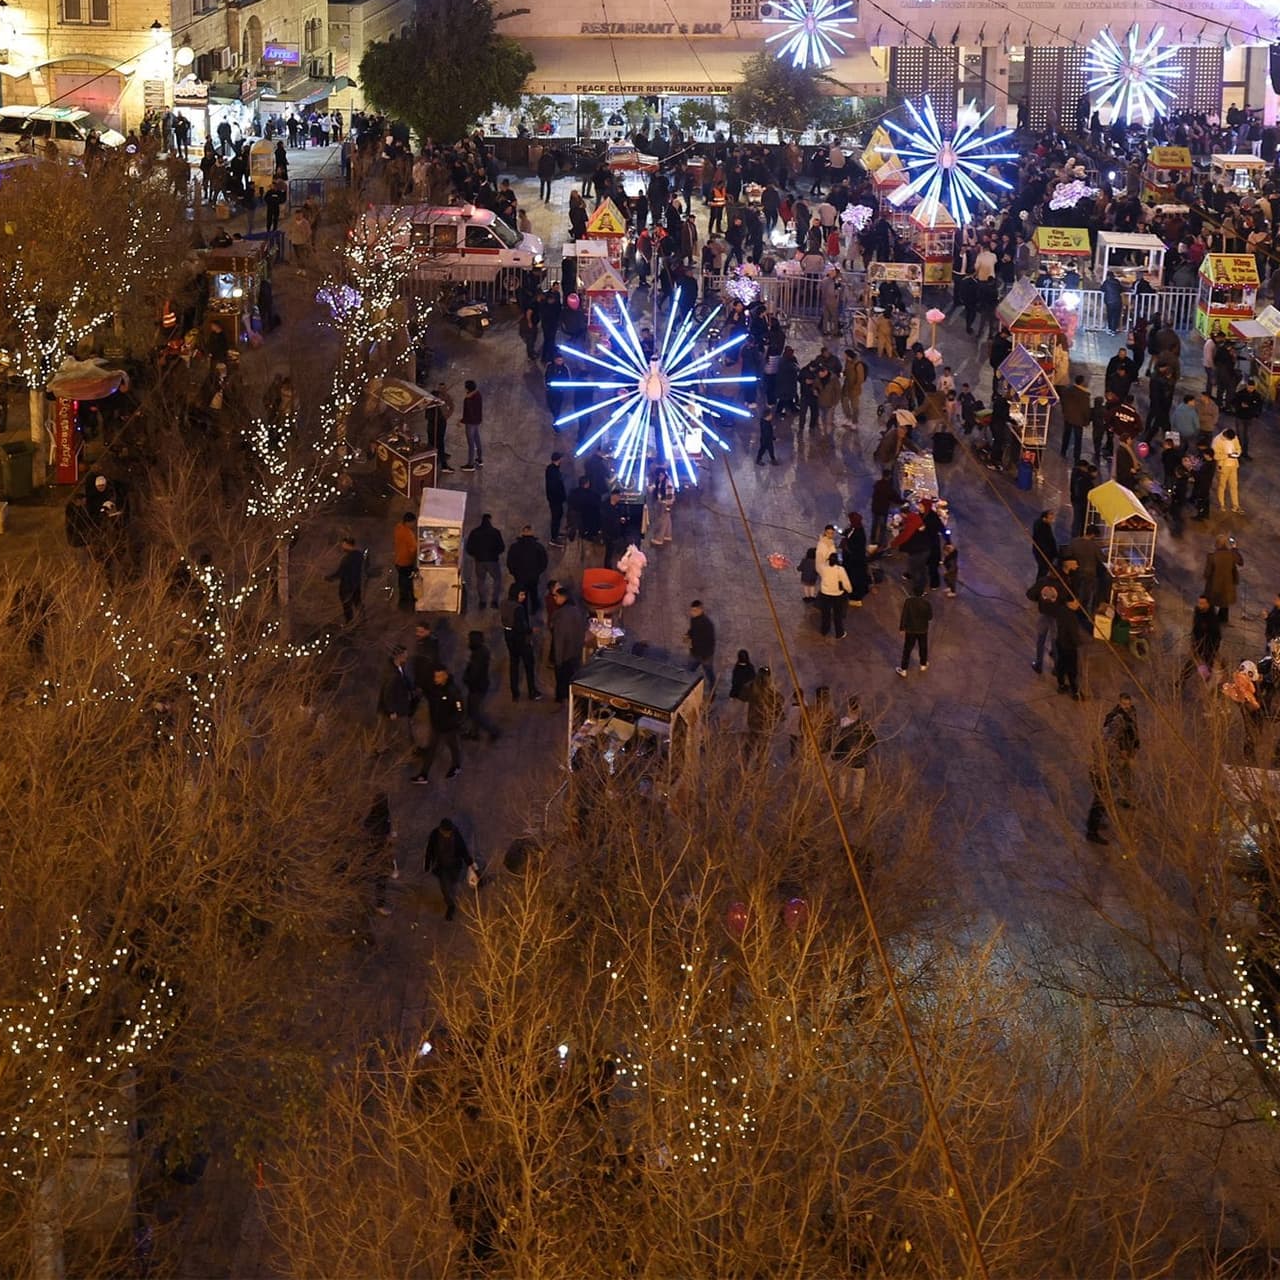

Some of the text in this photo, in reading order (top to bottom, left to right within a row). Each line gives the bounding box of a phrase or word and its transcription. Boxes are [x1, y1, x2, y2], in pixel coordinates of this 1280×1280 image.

[581, 22, 675, 34] RESTAURANT
[692, 23, 723, 34] BAR
[576, 84, 607, 93] PEACE
[608, 84, 643, 93] CENTER
[646, 84, 707, 93] RESTAURANT
[1233, 258, 1251, 268] King
